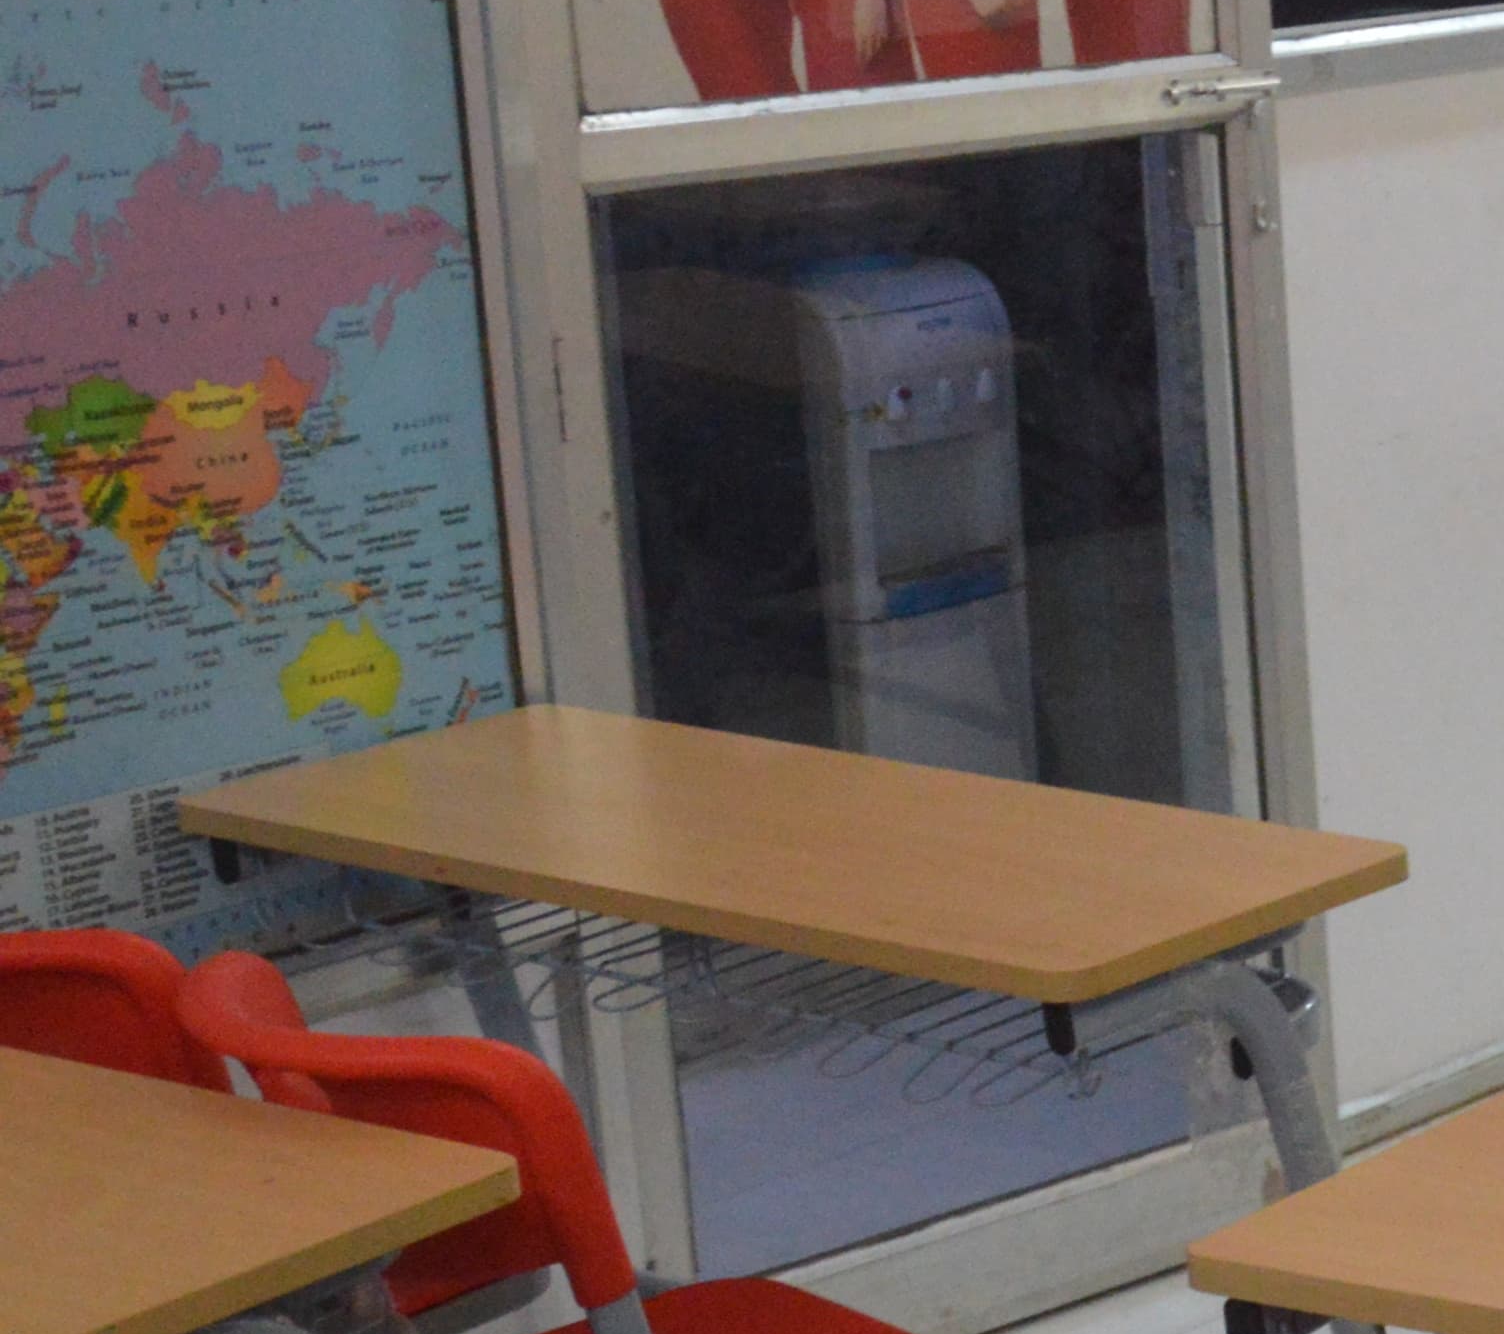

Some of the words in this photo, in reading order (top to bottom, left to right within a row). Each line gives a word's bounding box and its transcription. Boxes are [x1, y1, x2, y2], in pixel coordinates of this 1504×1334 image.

[126, 293, 282, 328] Russia
[195, 452, 250, 470] China
[307, 662, 377, 687] Australia
